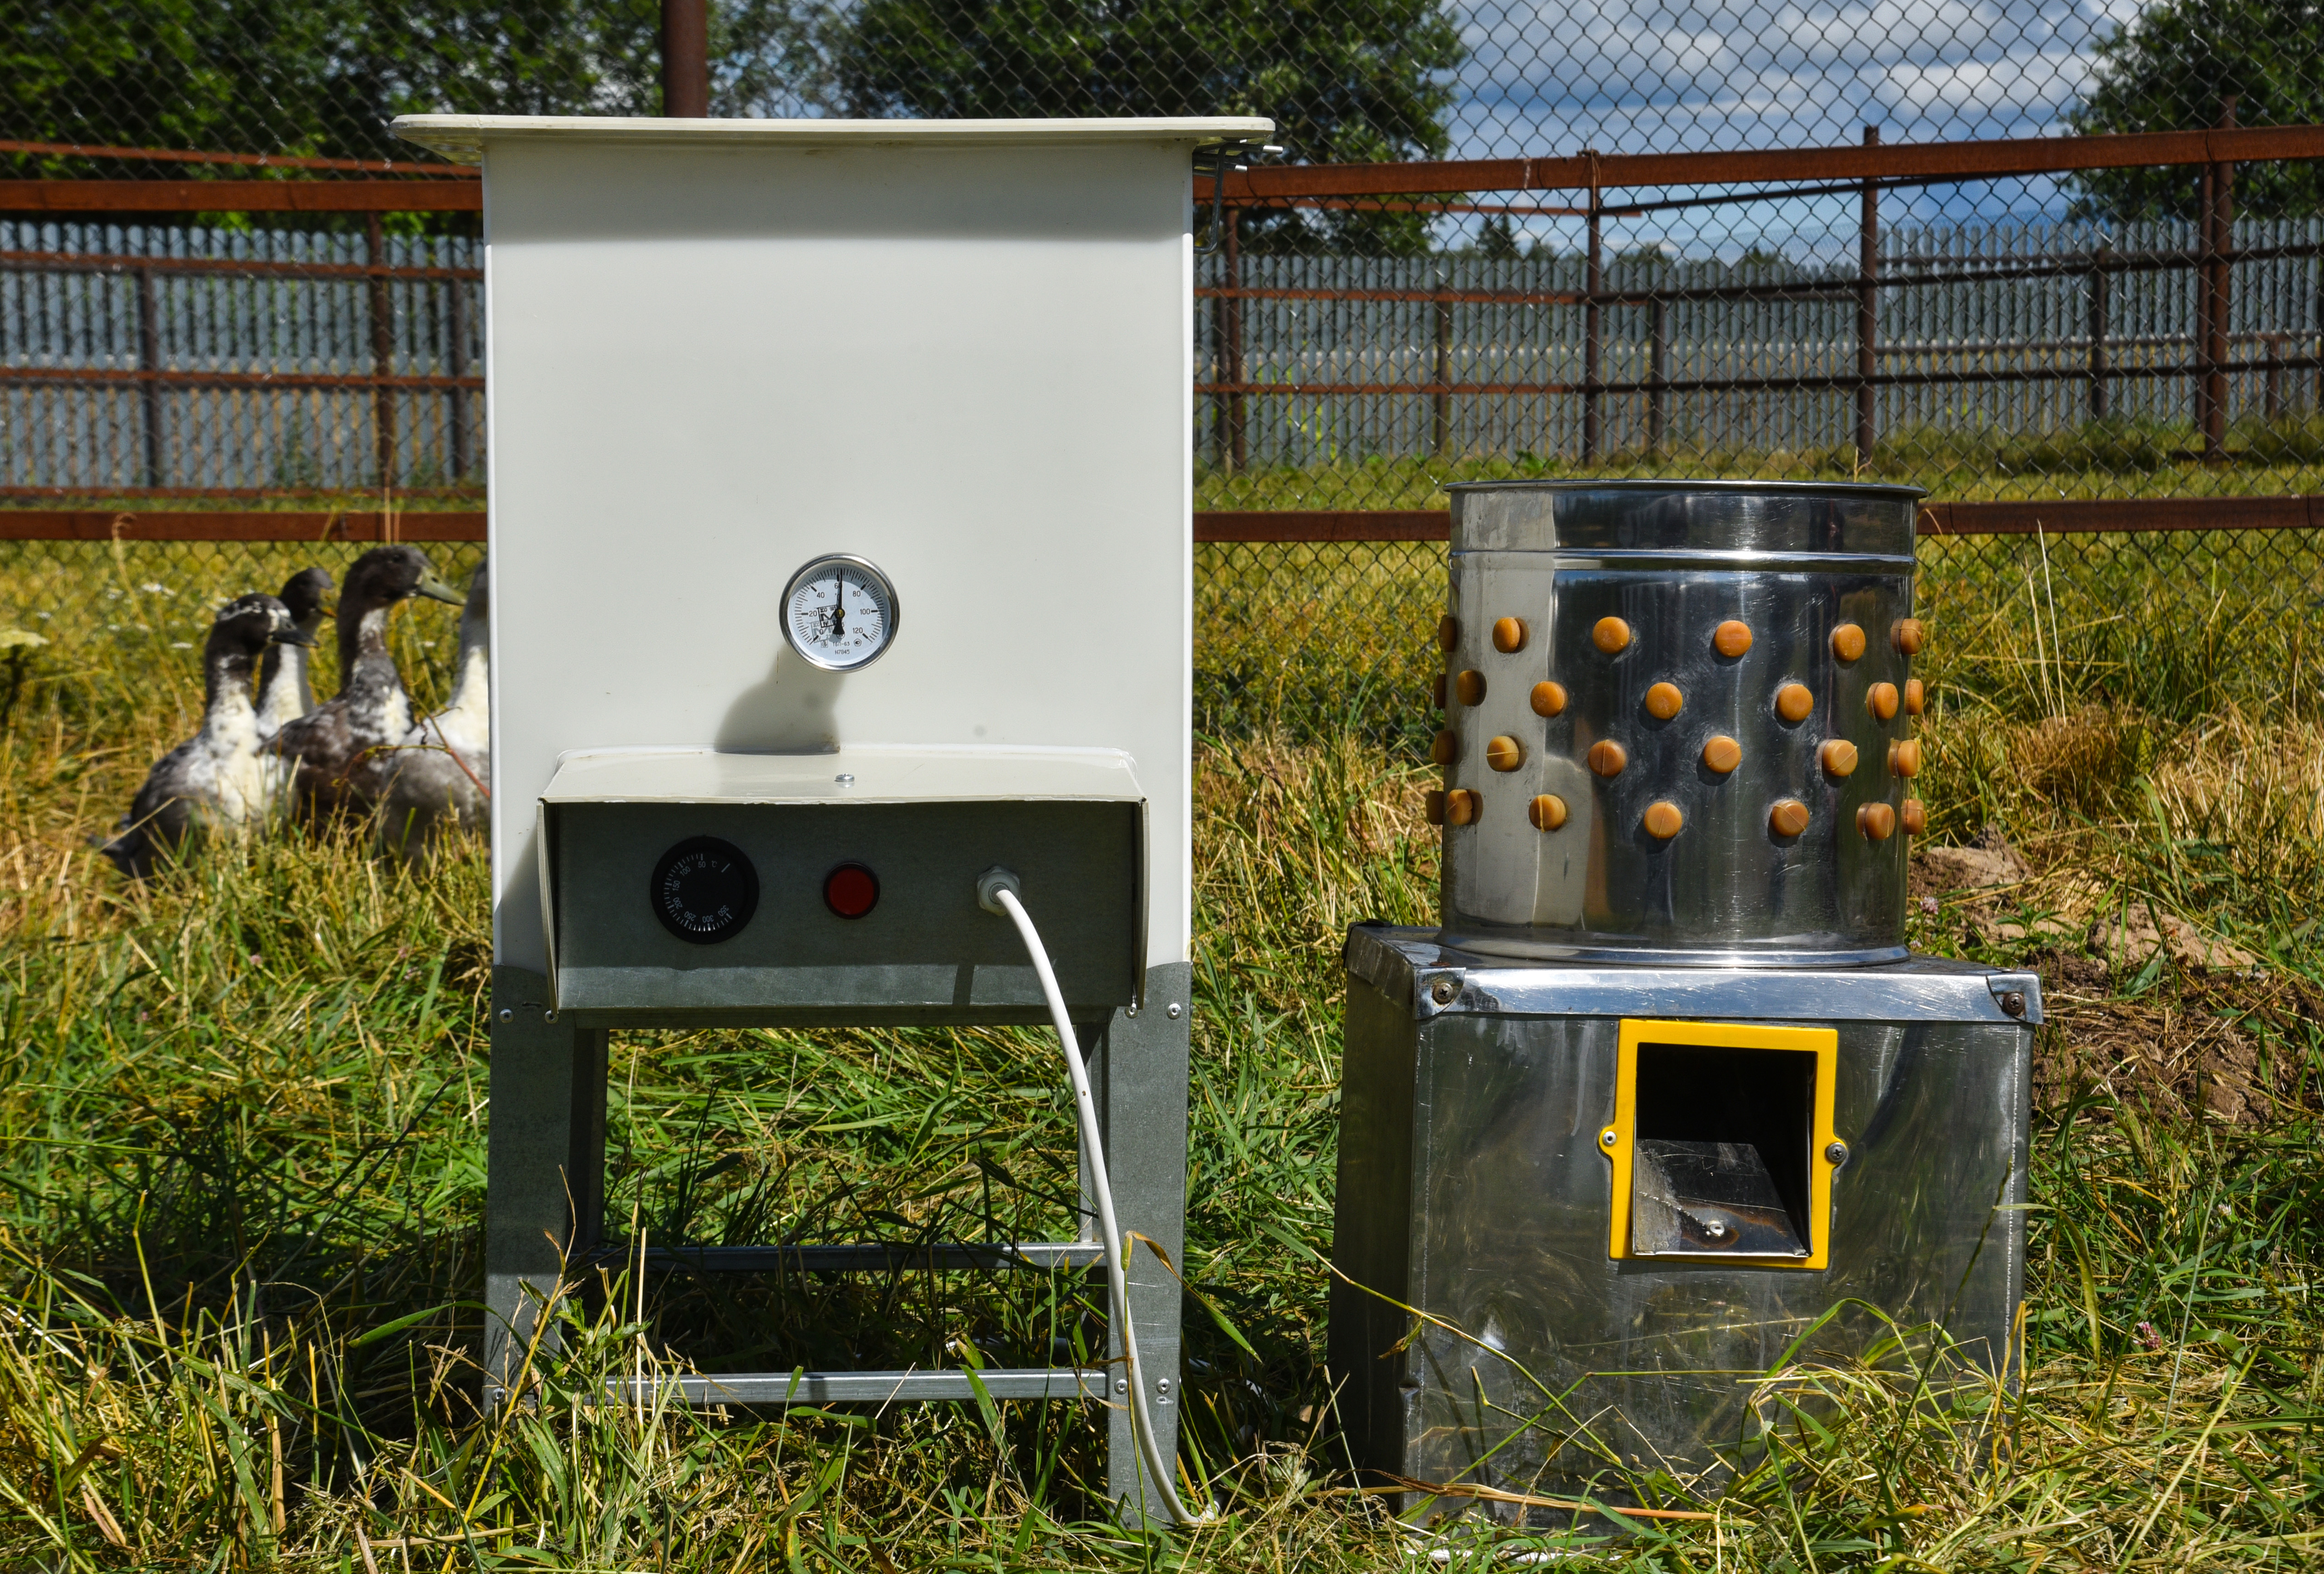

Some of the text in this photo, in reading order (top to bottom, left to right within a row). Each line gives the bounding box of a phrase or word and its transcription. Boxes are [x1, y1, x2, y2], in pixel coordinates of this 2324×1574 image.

[680, 866, 691, 877] 100
[672, 880, 681, 891] 150
[673, 897, 683, 909] 200
[684, 910, 697, 921] 250
[718, 905, 729, 917] 350
[702, 915, 714, 923] 300
